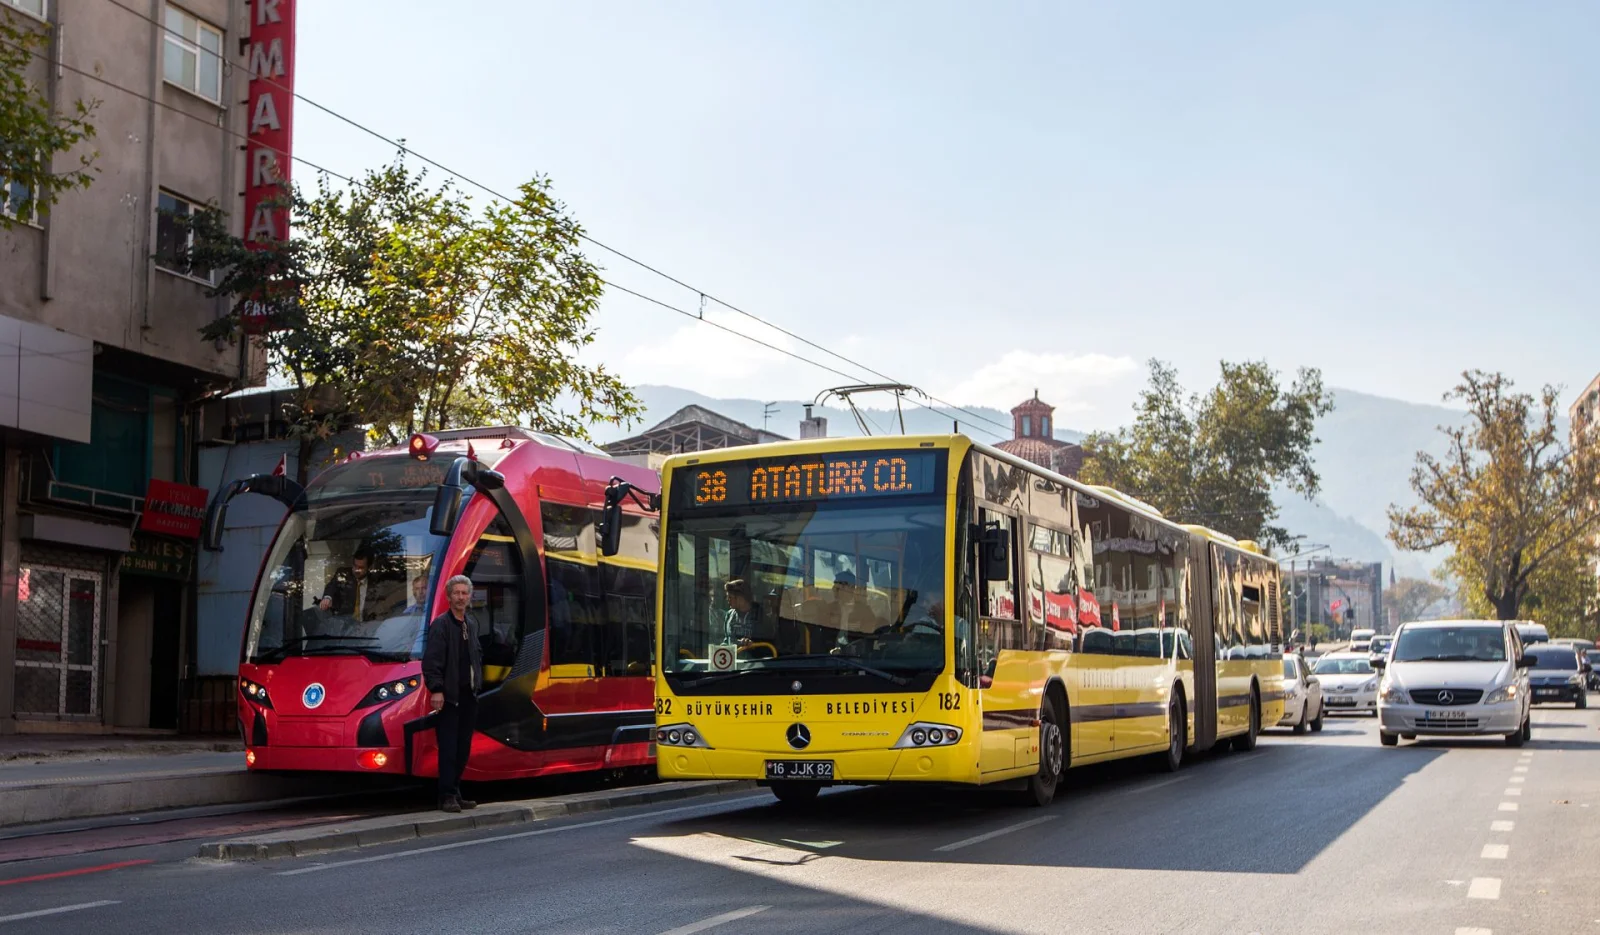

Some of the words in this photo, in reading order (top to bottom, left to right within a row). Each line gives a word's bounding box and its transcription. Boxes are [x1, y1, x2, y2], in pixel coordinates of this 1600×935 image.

[697, 470, 727, 503] 38
[873, 457, 912, 491] CD.
[719, 652, 727, 665] 3
[687, 701, 773, 719] BÜYÜKŞEHİR
[827, 698, 915, 715] BELEDİYESİ
[938, 692, 961, 711] 182
[773, 762, 785, 774] 16
[790, 763, 815, 775] JJK
[817, 763, 832, 775] 82
